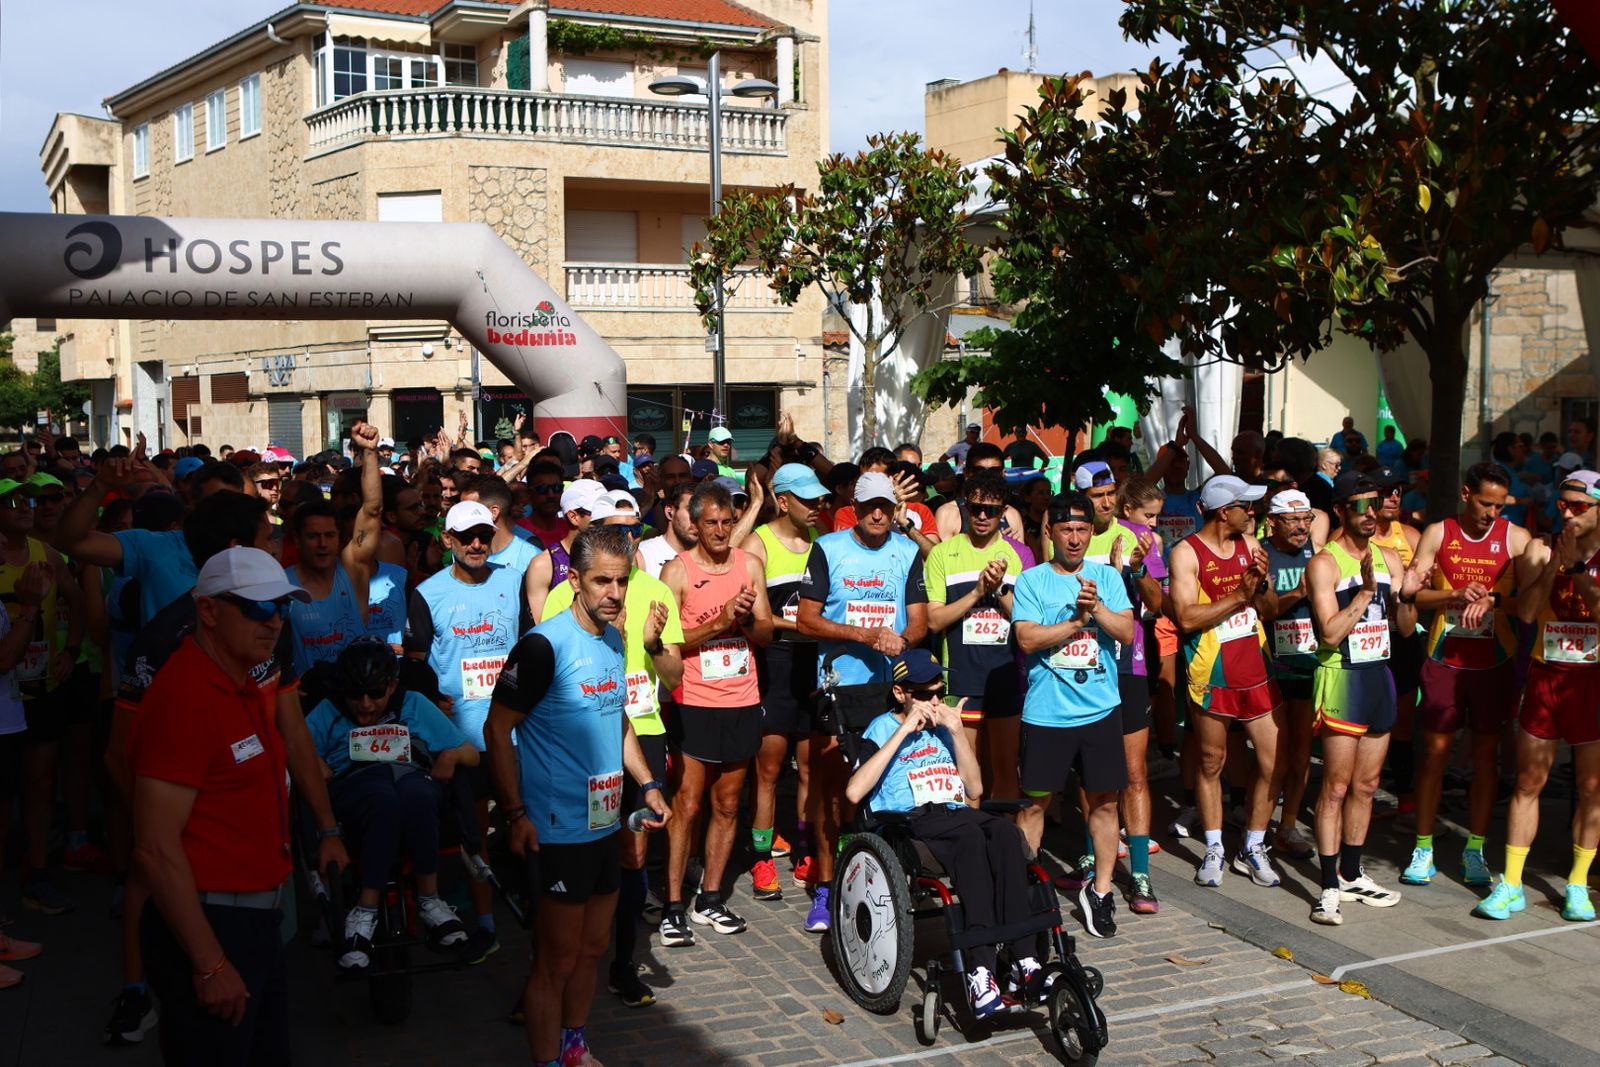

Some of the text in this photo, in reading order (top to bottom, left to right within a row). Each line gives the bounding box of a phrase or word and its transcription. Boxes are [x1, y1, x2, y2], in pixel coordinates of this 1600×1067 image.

[144, 237, 344, 276] HOSPES
[69, 288, 414, 310] PALACIO DE SAN ESTEBAN
[486, 328, 577, 346] bedunia
[1461, 566, 1484, 575] VINO
[1452, 573, 1492, 582] DE TORO
[848, 603, 895, 614] bedunia
[860, 617, 885, 629] 177
[975, 622, 999, 635] 262
[1276, 621, 1312, 631] beduni
[1287, 632, 1309, 644] 157
[1360, 637, 1382, 651] 297
[1557, 638, 1584, 651] 128
[1062, 643, 1089, 657] 302
[463, 658, 506, 671] beduni
[723, 655, 731, 667] 8
[477, 672, 501, 688] 10
[370, 739, 390, 753] 64
[925, 778, 953, 792] 176
